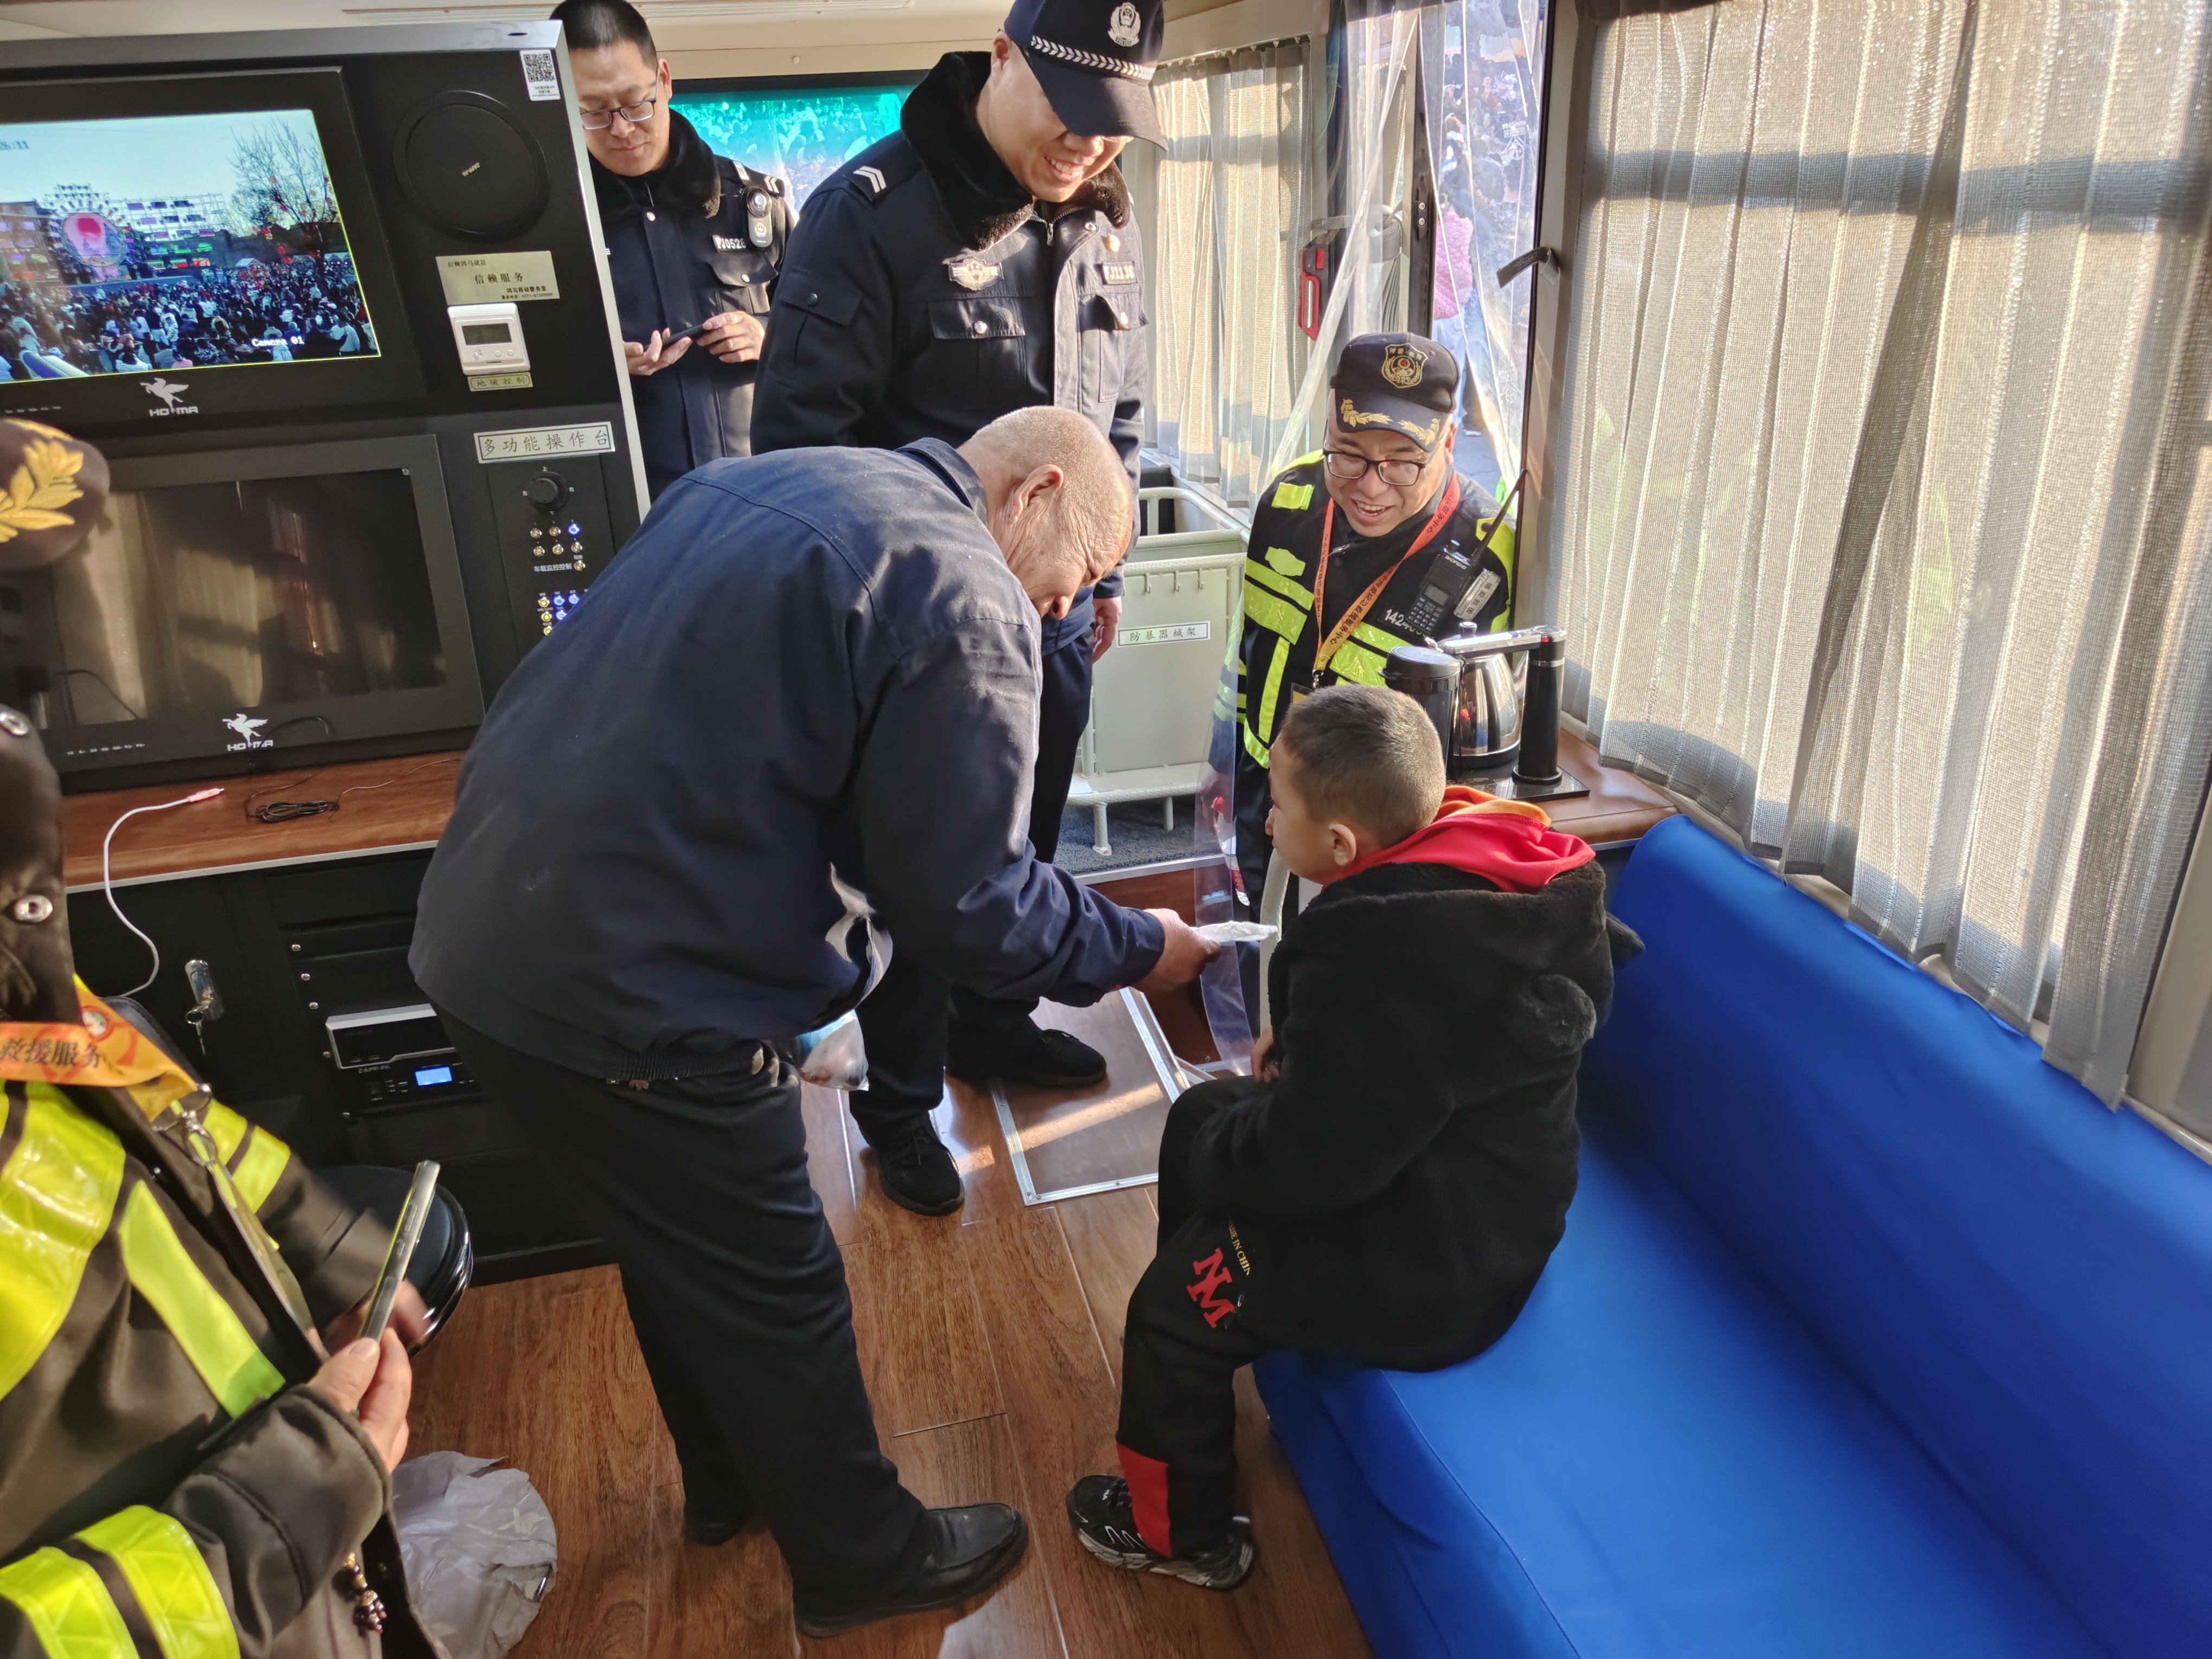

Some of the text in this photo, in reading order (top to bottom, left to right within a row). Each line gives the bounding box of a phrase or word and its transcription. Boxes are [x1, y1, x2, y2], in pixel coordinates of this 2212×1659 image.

[474, 273, 524, 285] 信赖服务
[291, 336, 305, 345] 01
[477, 376, 525, 387] 地暖控制
[484, 430, 608, 457] 多功能操作台
[1445, 555, 1467, 570] BAOFENG
[1130, 627, 1196, 642] 防暴器械架
[1232, 1238, 1242, 1251] IN
[1237, 1250, 1251, 1276] CHIN
